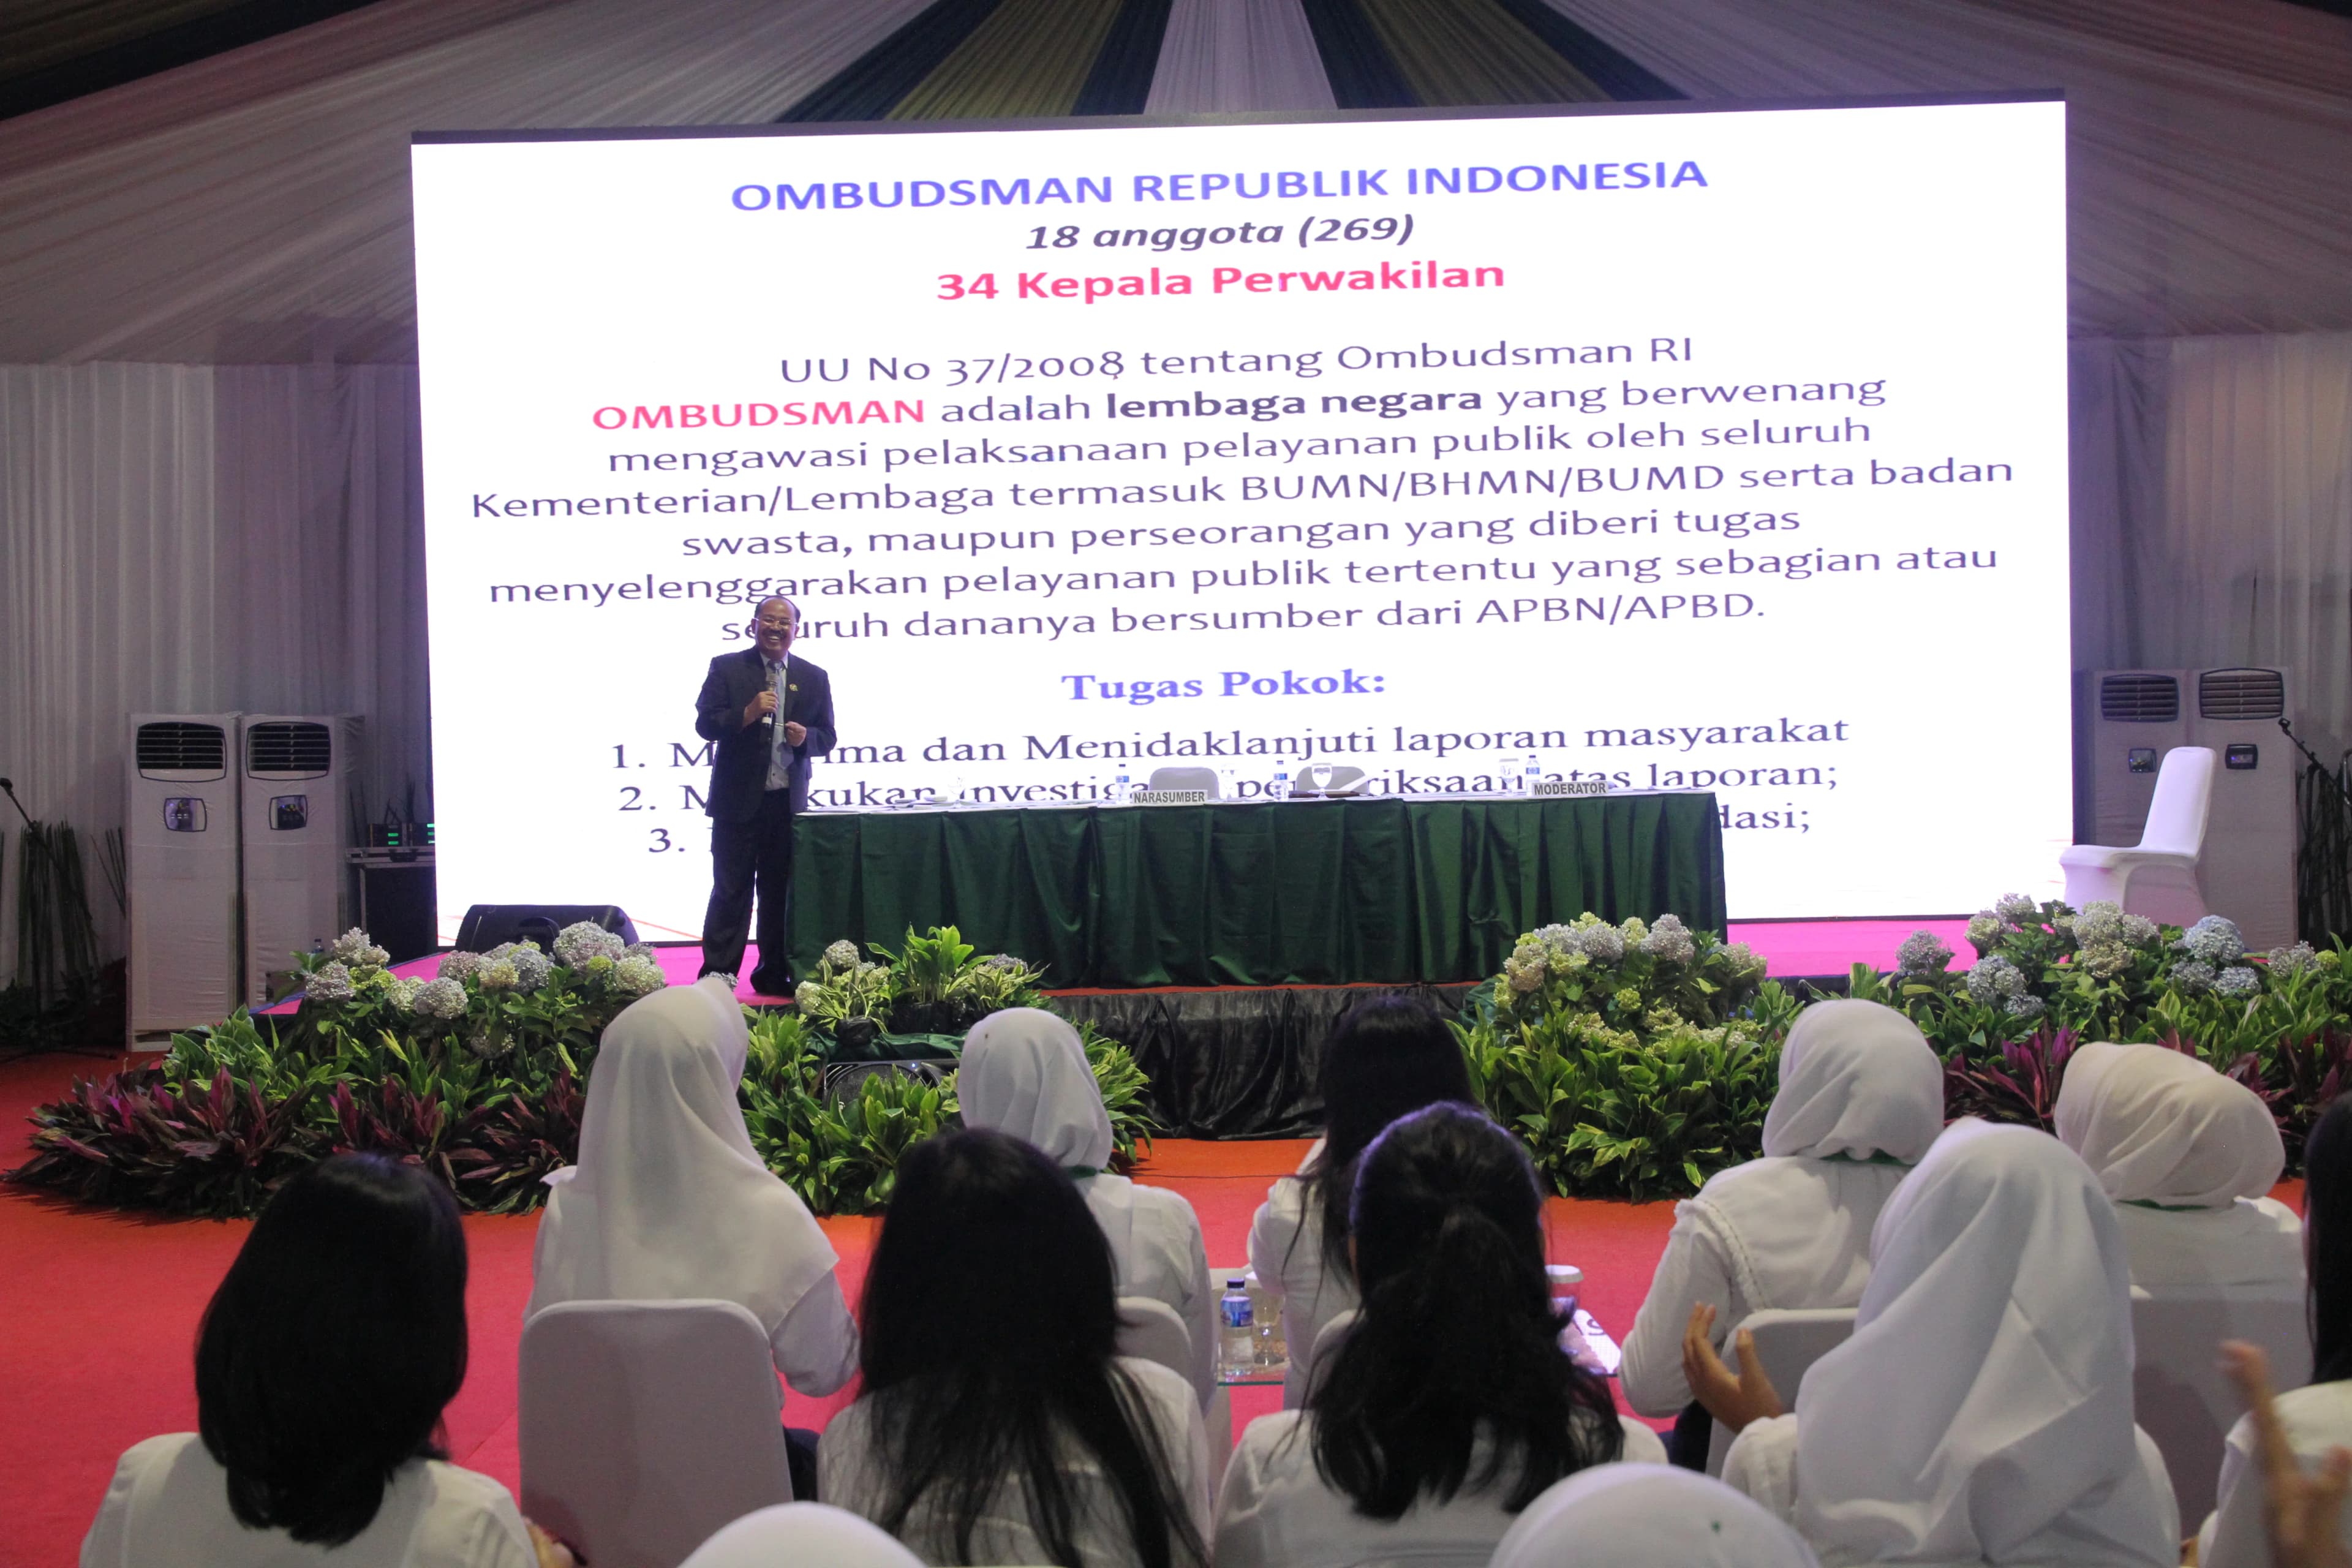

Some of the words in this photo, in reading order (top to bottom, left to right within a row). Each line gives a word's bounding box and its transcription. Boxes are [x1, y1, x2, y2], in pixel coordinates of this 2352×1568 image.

[732, 176, 1112, 211] OMBUDSMAN
[1134, 169, 1389, 202] REPUBLIK
[1408, 161, 1708, 195] INDONESIA
[1026, 225, 1080, 249] 18
[1093, 222, 1284, 252] anggota
[1298, 214, 1413, 248] (269)
[937, 273, 999, 300] 34
[1018, 267, 1192, 304] Kepala
[1213, 260, 1504, 293] Perwakilan
[782, 358, 848, 382] UU
[869, 357, 930, 381] No
[946, 351, 1124, 386] 37/2008
[1140, 350, 1322, 378] tentang
[1338, 341, 1632, 369] Ombudsman
[1651, 337, 1691, 361] RI
[593, 400, 924, 429] OMBUDSMAN
[941, 394, 1090, 422] adalah
[1107, 391, 1305, 421] lembaga
[1321, 392, 1482, 418] negara
[1497, 387, 1607, 416] yang
[1623, 380, 1886, 406] berwenang
[609, 442, 867, 477] mengawasi
[884, 438, 1166, 473] pelaksanaan
[1184, 432, 1416, 466] pelayanan
[1433, 424, 1572, 460] publik
[1587, 422, 1684, 448] oleh
[1702, 417, 1869, 445] seluruh
[473, 483, 993, 518] Kementerian/Lembaga
[1009, 476, 1225, 506] termasuk
[1242, 466, 1724, 502] BUMN/BHMN/BUMD
[1740, 464, 1853, 488] serta
[1871, 457, 2011, 484] badan
[683, 531, 852, 558] swasta,
[869, 531, 1054, 557] maupun
[1072, 522, 1389, 554] perseorangan
[1405, 518, 1514, 546] yang
[1529, 509, 1657, 536] diberi
[1674, 510, 1800, 538] tugas
[491, 570, 926, 607] menyelenggarakan
[944, 566, 1175, 600] pelayanan
[1193, 559, 1330, 594] publik
[1344, 558, 1535, 583] tertentu
[1551, 557, 1661, 586] yang
[1676, 548, 1880, 579] sebagian
[1897, 548, 1996, 570] atau
[722, 612, 888, 641] suruh
[905, 611, 1095, 641] dananya
[1112, 603, 1363, 631] bersumber
[1377, 600, 1461, 625] dari
[1476, 594, 1764, 625] APBN/APBD.
[1061, 675, 1203, 706] Tugas
[1219, 668, 1384, 696] Pokok:
[612, 744, 645, 768] 1.
[923, 737, 1007, 761] dan
[1022, 728, 1377, 767] Menidaklanjuti
[1393, 726, 1568, 758] laporan
[1584, 717, 1849, 752] masyarakat
[619, 786, 656, 810] 2.
[1648, 763, 1836, 790] laporan;
[1134, 791, 1205, 803] NARASUMBER
[1534, 783, 1607, 795] MODERATOR
[649, 828, 685, 853] 3.
